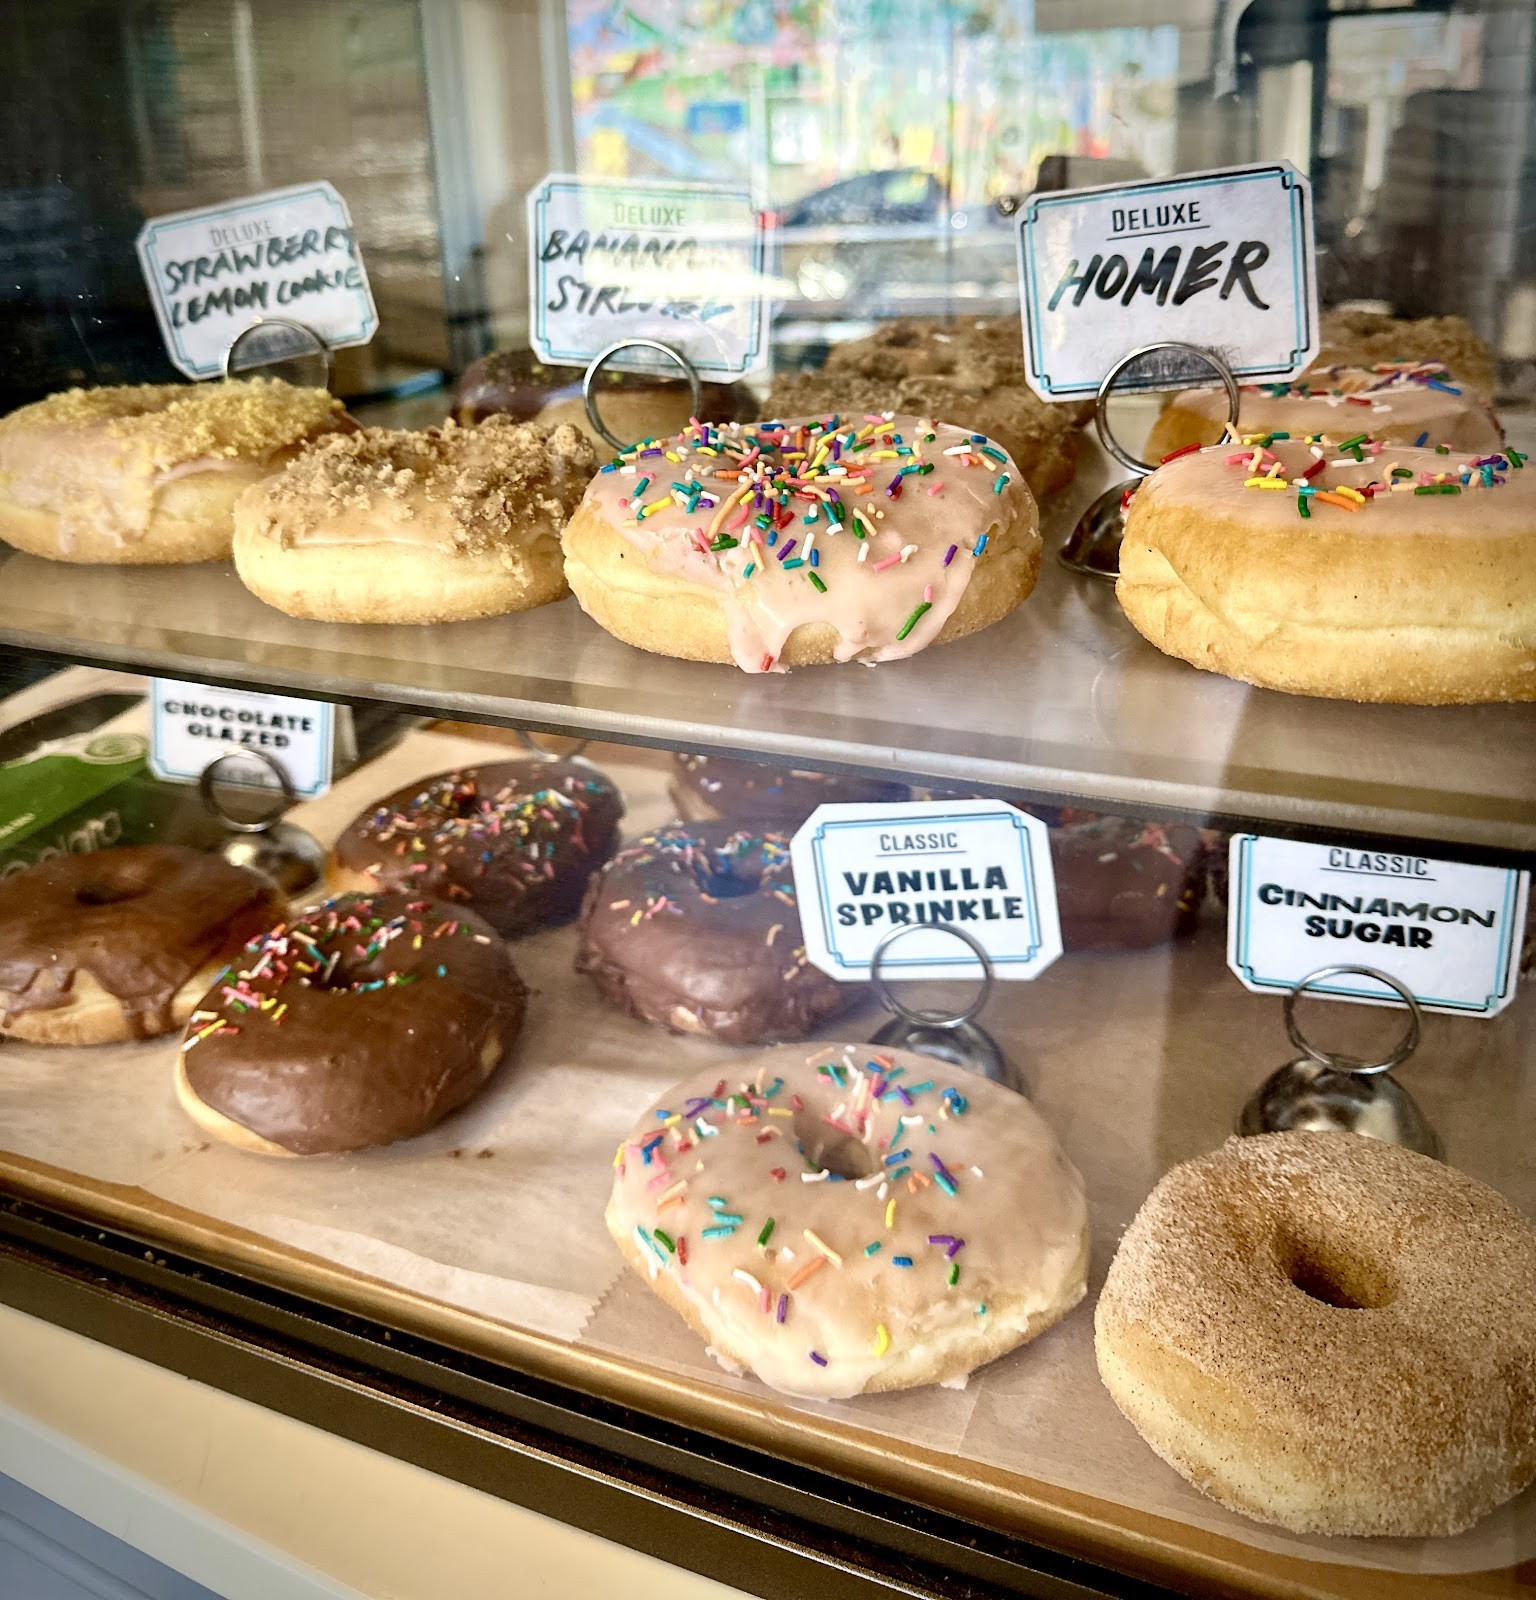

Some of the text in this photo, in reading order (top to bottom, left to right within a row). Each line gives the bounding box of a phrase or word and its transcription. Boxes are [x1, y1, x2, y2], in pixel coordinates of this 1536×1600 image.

[614, 203, 686, 226] DELUXE
[1111, 201, 1200, 233] DELUXE
[210, 219, 273, 247] DELUXE
[165, 225, 357, 295] STRAWBERRY
[540, 229, 698, 271] BANANA
[1047, 240, 1270, 312] HOMER
[171, 265, 362, 328] LEMON COOKIE
[163, 698, 314, 732] CHOCOLATE
[187, 721, 291, 748] GLAZED
[879, 832, 959, 852] CLASSIC
[1329, 847, 1428, 877] CLASSIC
[842, 865, 1008, 896] VANILLA
[837, 896, 1024, 926] SPRINKLE
[1257, 882, 1496, 929] CINNAMON
[1305, 914, 1433, 950] SUGAR
